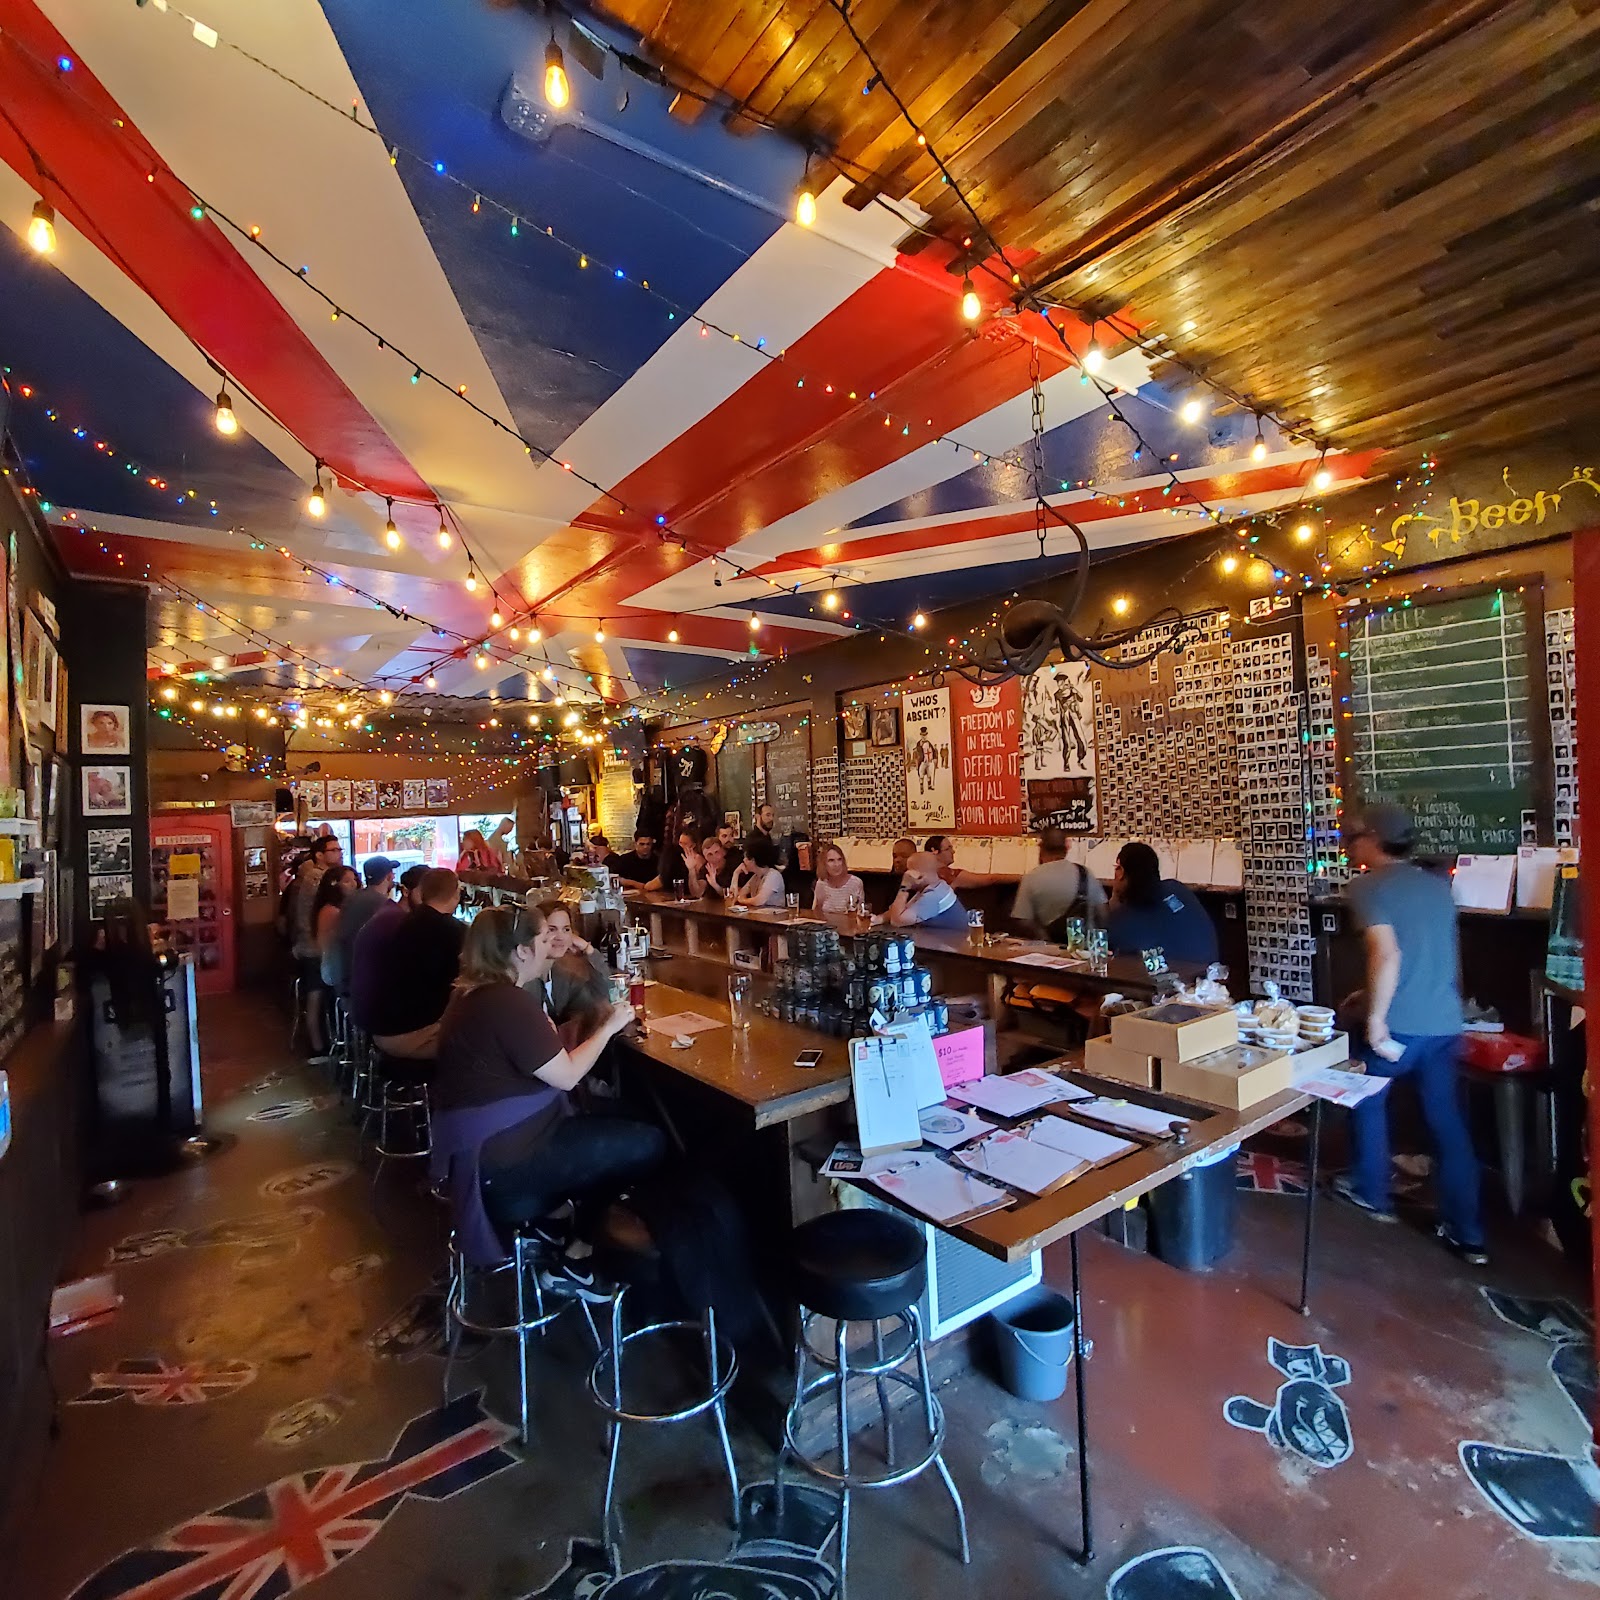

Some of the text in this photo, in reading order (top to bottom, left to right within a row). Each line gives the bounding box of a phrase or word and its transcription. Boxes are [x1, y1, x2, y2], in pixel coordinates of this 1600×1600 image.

[1571, 466, 1595, 480] is
[1430, 490, 1562, 546] Beer
[910, 694, 938, 708] WHO'S
[906, 707, 946, 722] ABSENT?
[960, 709, 1015, 733] FREEDOM IS
[967, 733, 1006, 751] IN PERIL
[963, 752, 1019, 779] DEFEND IT
[959, 780, 1006, 802] WITH ALL
[960, 805, 985, 825] YOUR
[988, 804, 1020, 826] MIGHT
[1459, 828, 1477, 842] ALL
[1482, 828, 1517, 843] PINTS
[938, 1046, 952, 1058] $10
